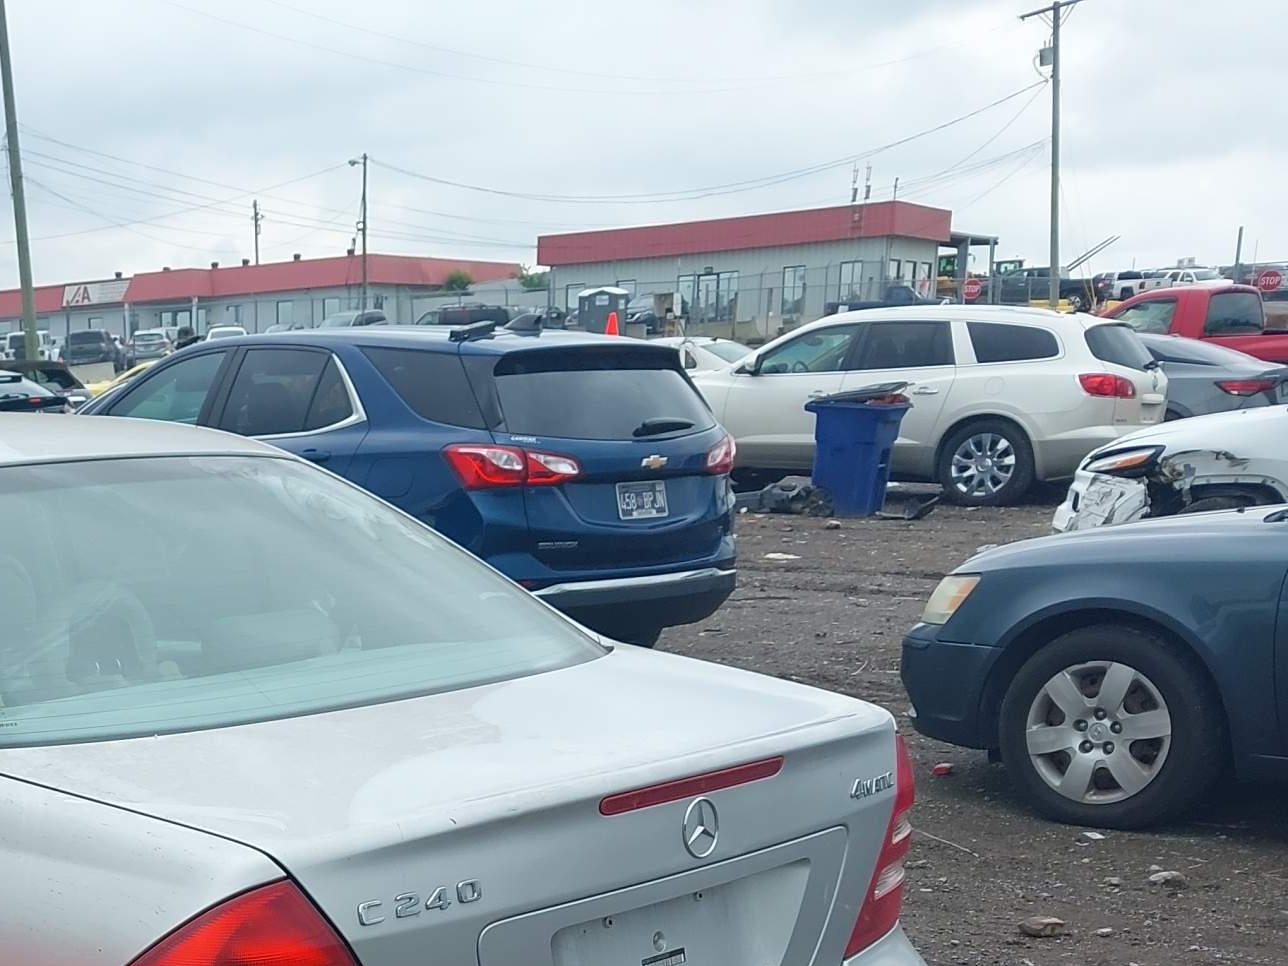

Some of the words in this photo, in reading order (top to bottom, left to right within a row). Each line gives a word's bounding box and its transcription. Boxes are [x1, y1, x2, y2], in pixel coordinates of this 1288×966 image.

[1261, 276, 1281, 286] STOP
[357, 899, 385, 926] C
[394, 878, 482, 919] 240
